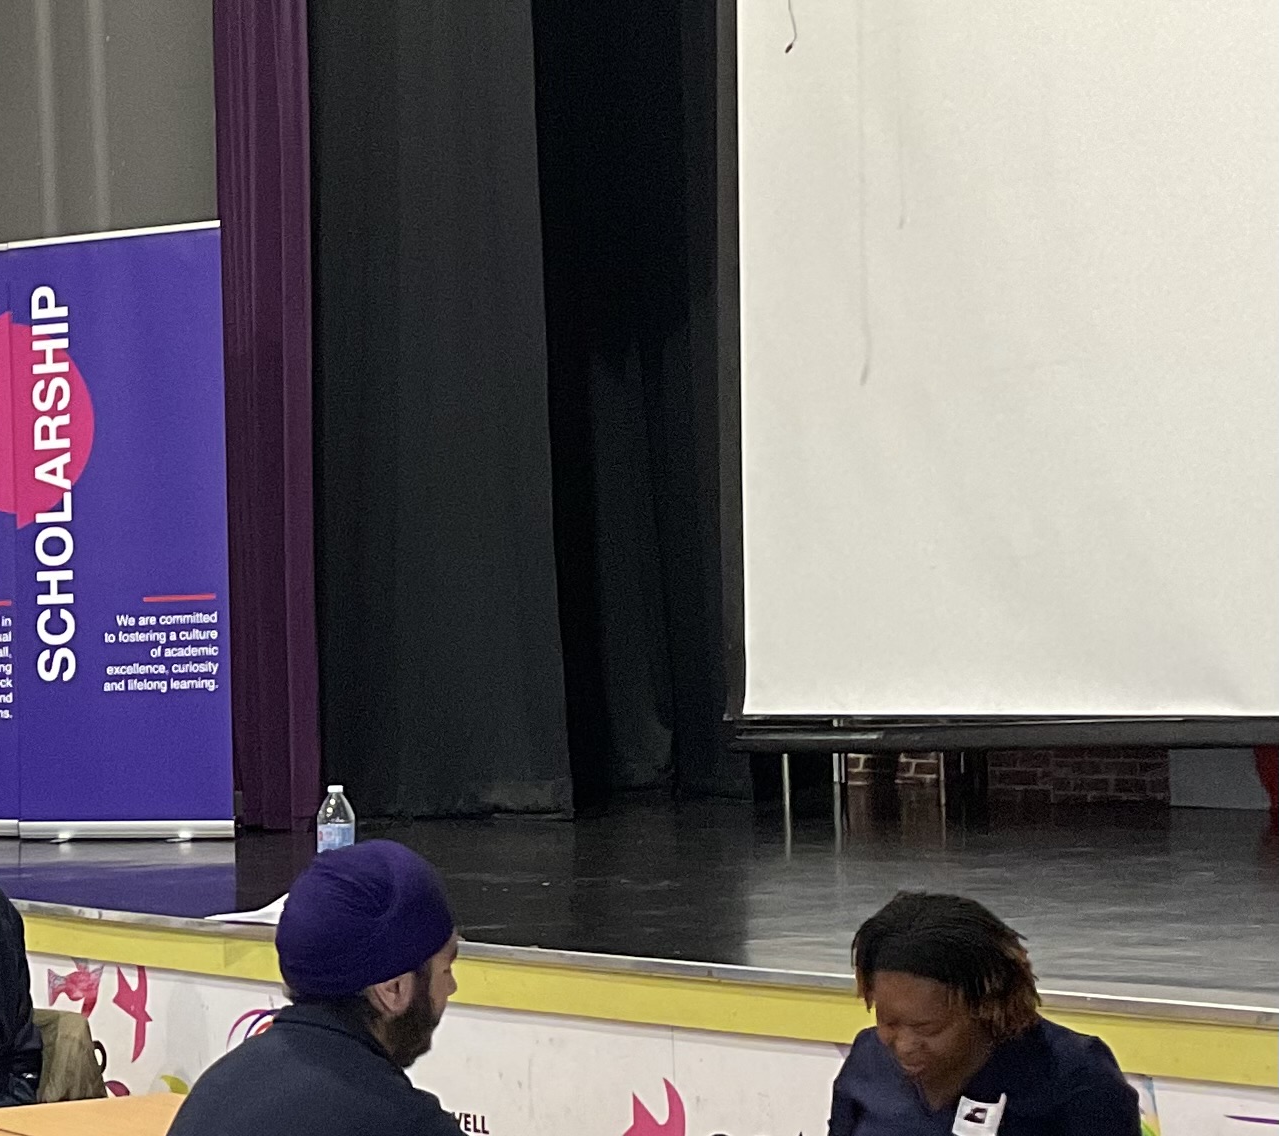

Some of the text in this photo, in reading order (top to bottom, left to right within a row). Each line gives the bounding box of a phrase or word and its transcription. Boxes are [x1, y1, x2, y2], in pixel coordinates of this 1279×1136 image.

[30, 285, 77, 683] SCHOLARSHIP
[1, 615, 12, 627] in
[116, 611, 218, 627] We are committed
[104, 628, 218, 644] to fostering a culture
[150, 644, 219, 658] of academic
[106, 661, 219, 676] excellence, curiosity
[103, 677, 219, 693] and lifelong learning.
